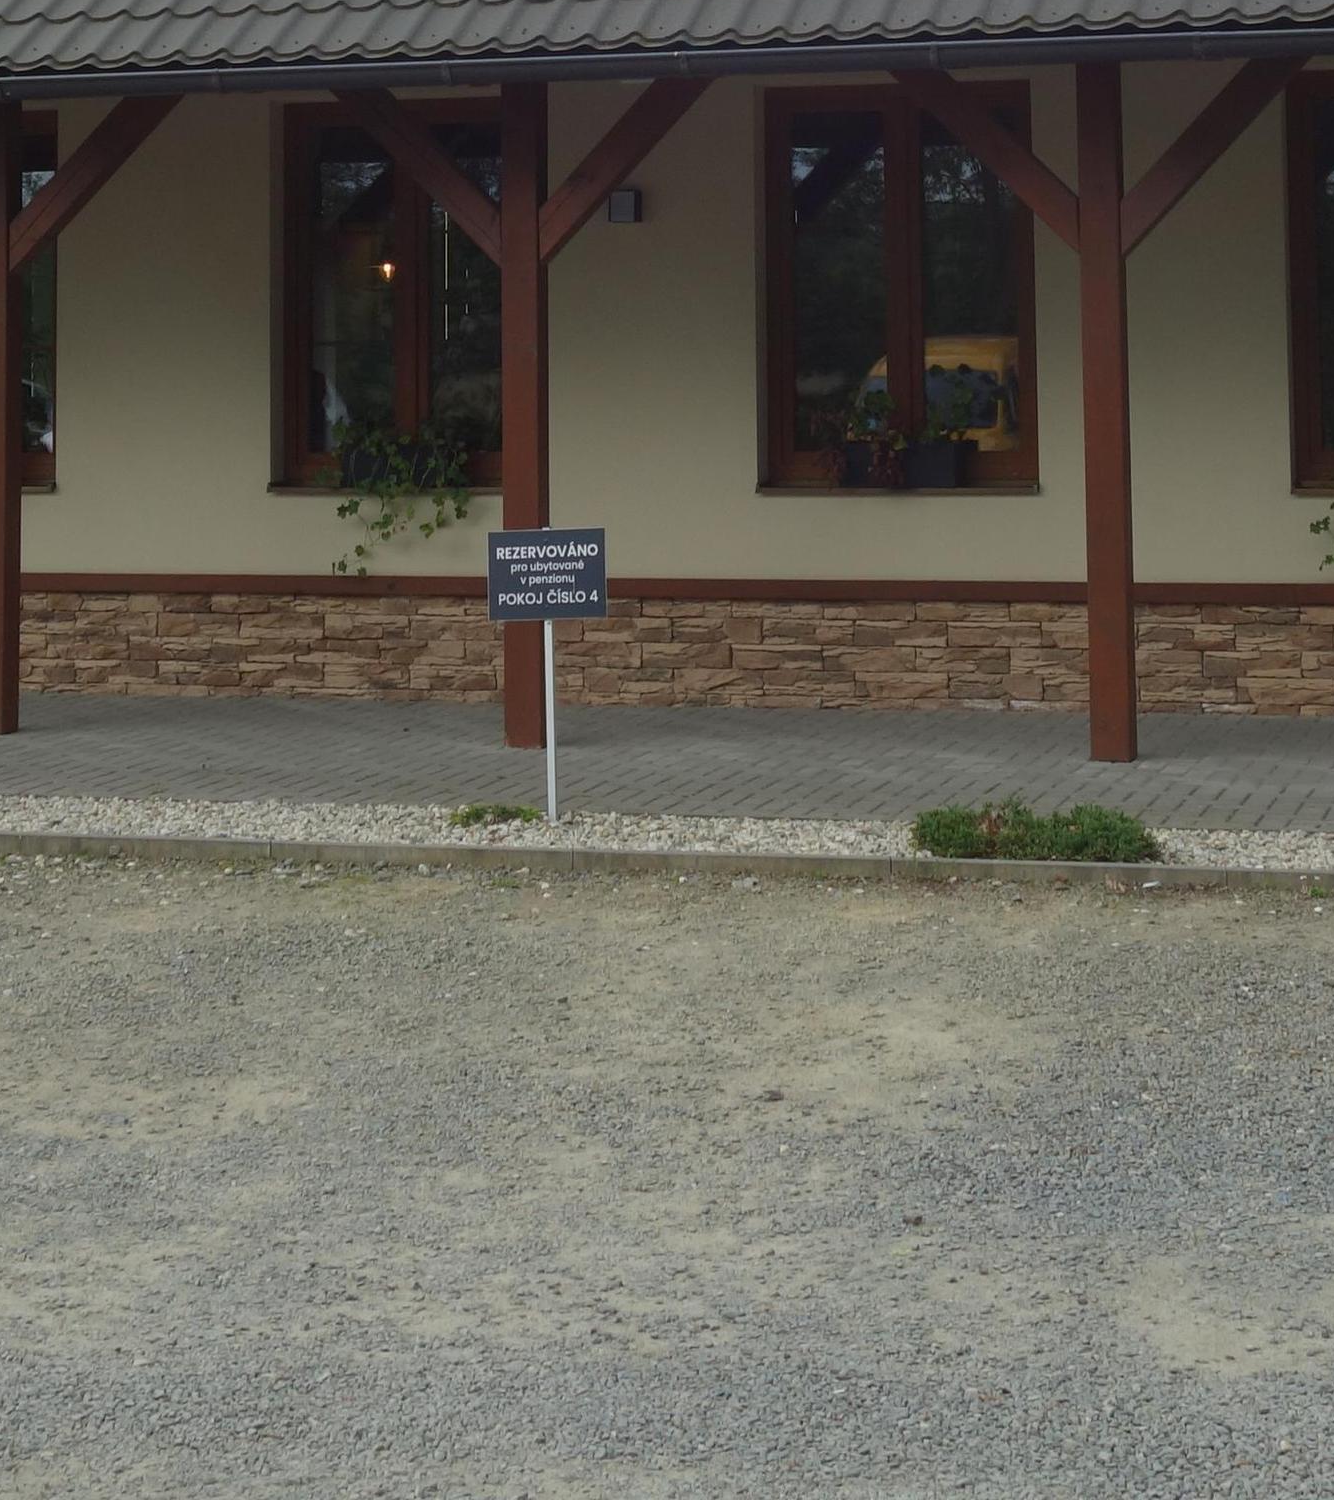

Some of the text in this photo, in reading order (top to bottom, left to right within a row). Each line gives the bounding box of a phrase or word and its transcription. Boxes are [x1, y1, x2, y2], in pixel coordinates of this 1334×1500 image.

[496, 541, 599, 560] REZERVOVÁNO
[510, 563, 528, 575] pro
[520, 573, 575, 587] v penzionu
[498, 588, 599, 606] POKOJ ČÍSLO 4
